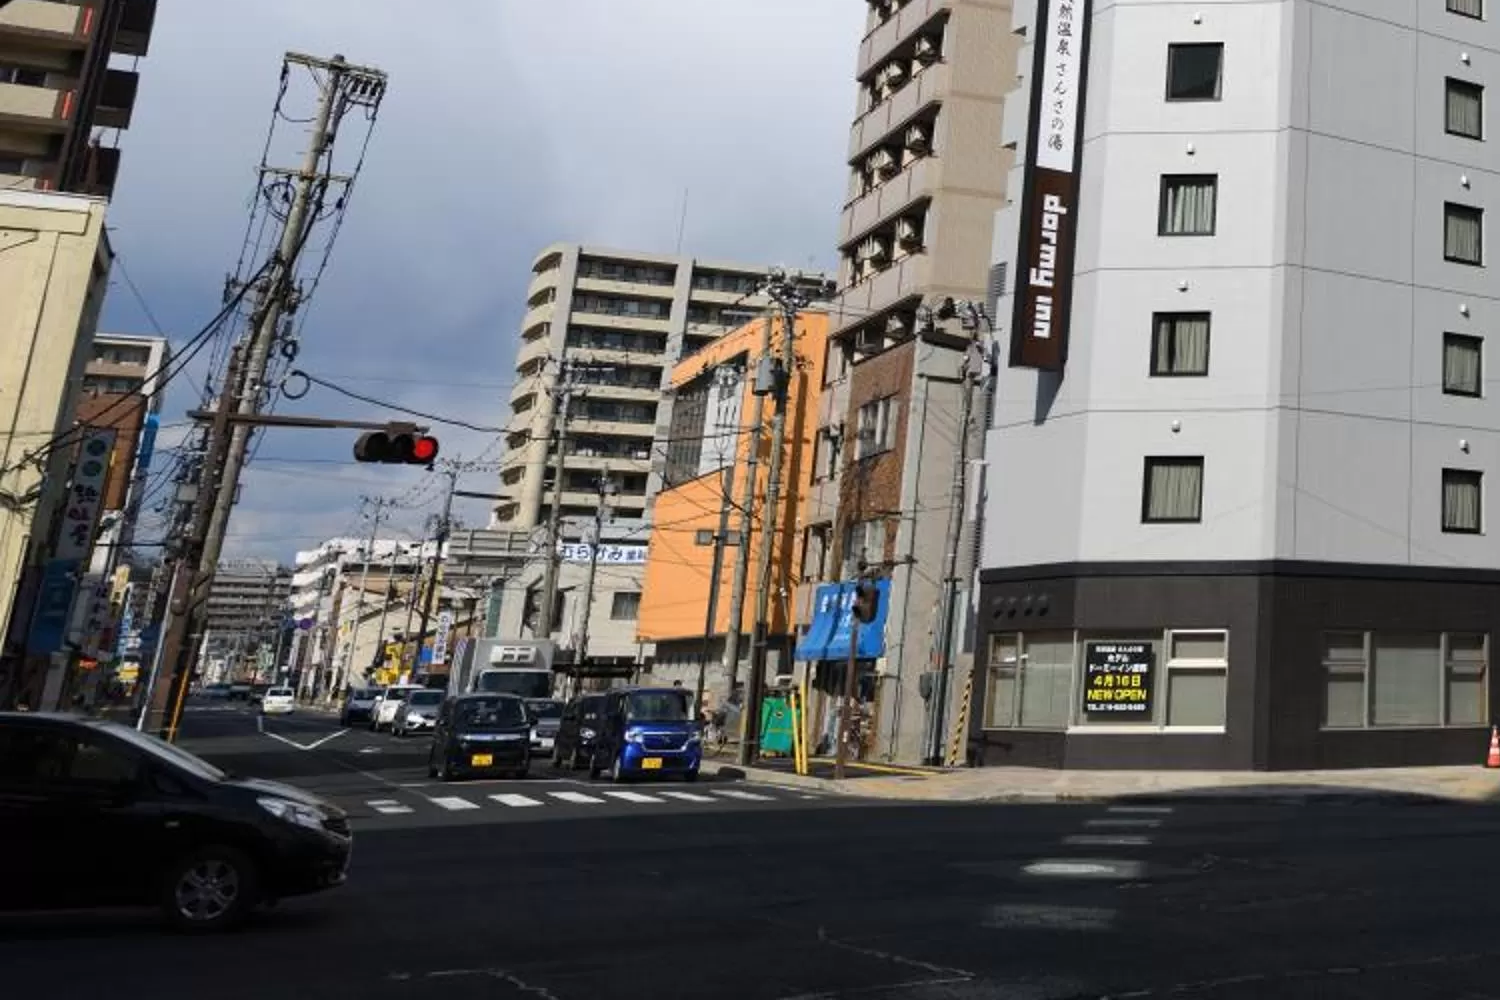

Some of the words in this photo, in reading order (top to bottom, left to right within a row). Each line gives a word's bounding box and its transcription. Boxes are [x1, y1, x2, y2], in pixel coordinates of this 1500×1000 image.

[1029, 193, 1068, 288] dormy
[1033, 295, 1054, 339] inn
[1087, 688, 1113, 701] NEW
[1114, 688, 1148, 701] OPEN
